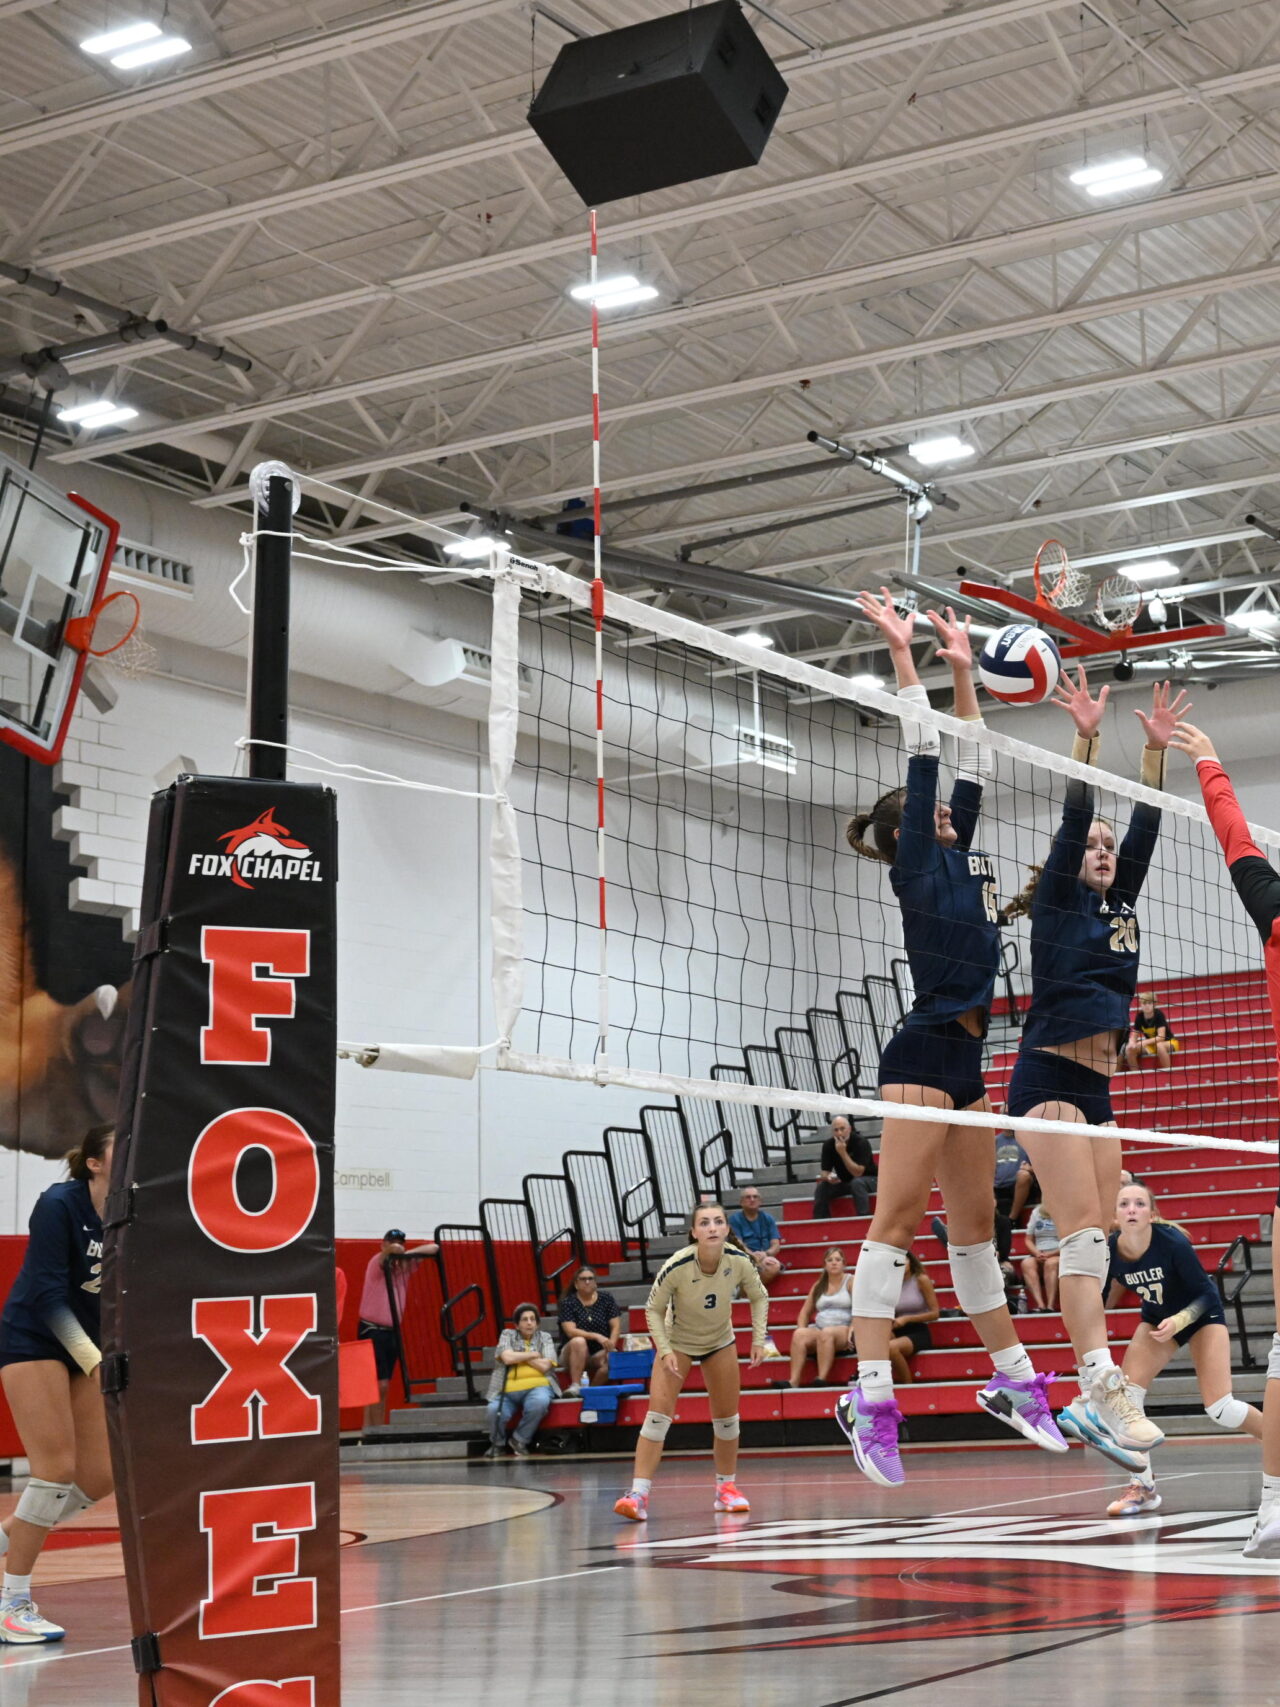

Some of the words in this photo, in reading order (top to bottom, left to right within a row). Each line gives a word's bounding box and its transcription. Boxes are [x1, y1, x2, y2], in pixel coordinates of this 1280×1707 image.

[188, 853, 235, 876] FOX
[241, 857, 323, 881] CHAPEL
[1109, 916, 1138, 953] 20
[1124, 1266, 1164, 1285] BUTLER
[704, 1293, 717, 1309] 3
[187, 925, 323, 1707] FOXE
